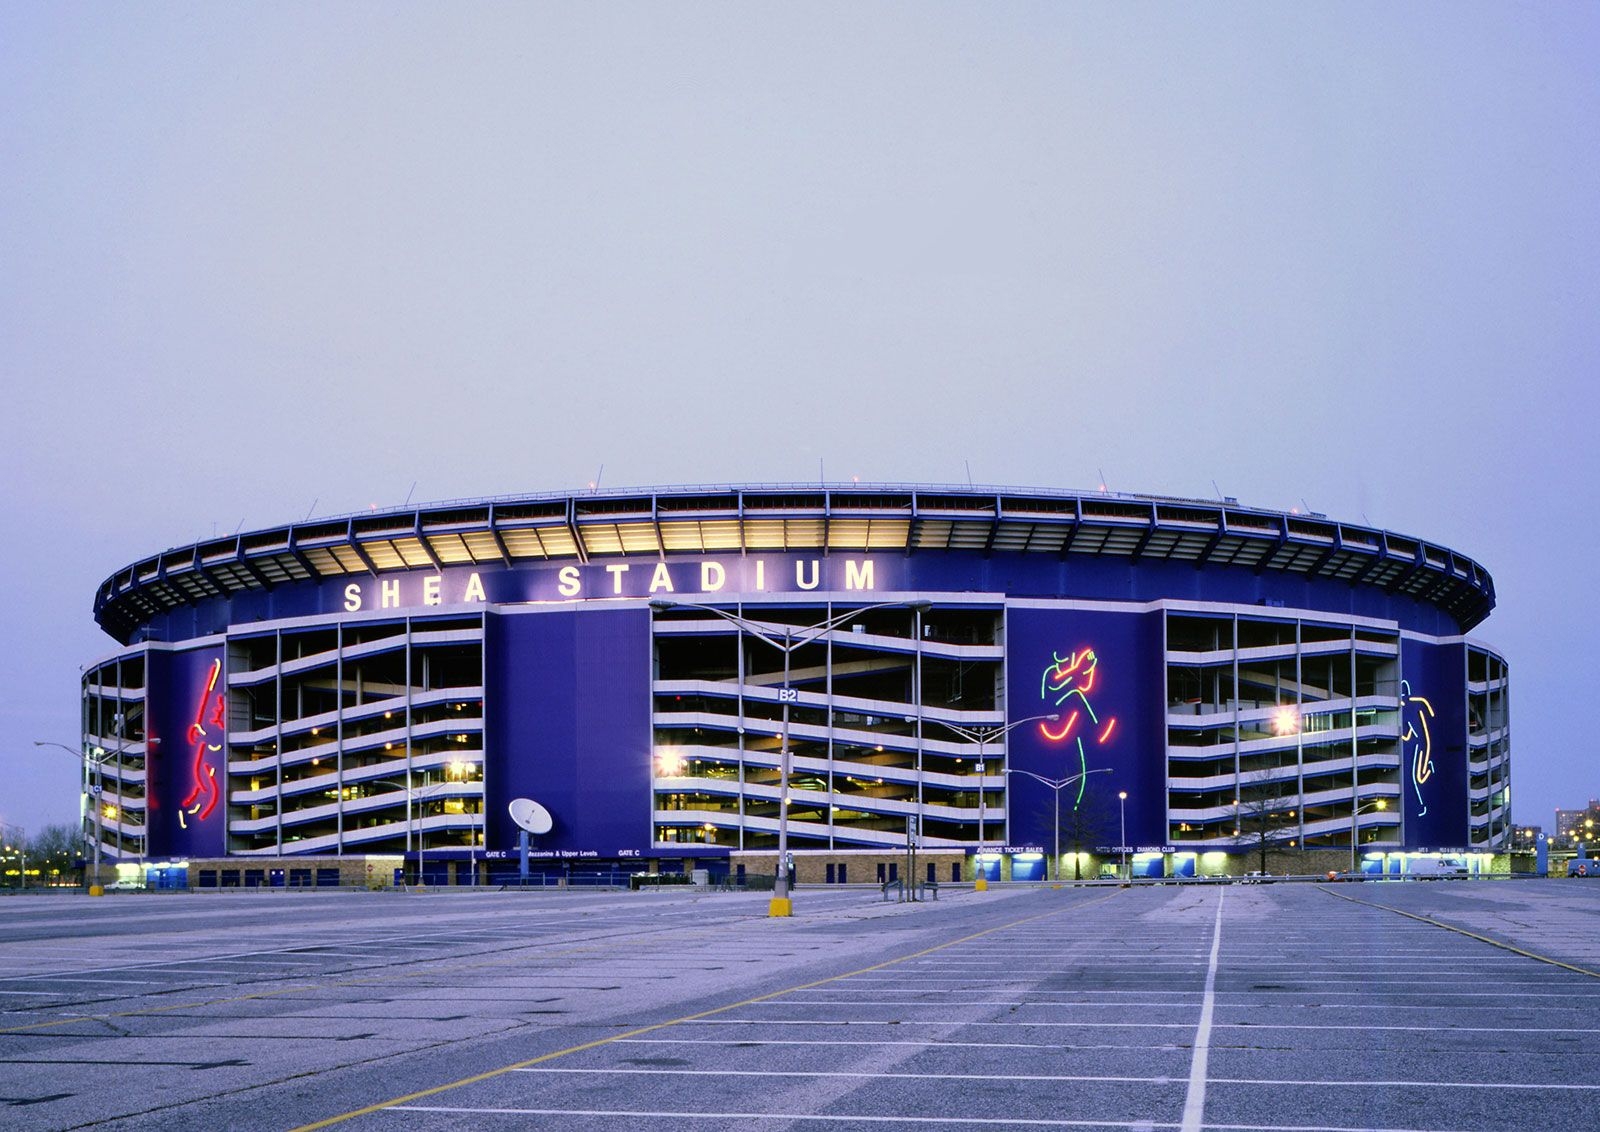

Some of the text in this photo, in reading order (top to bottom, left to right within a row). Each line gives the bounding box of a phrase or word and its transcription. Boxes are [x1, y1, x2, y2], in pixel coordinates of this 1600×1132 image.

[344, 560, 874, 612] SHEA STADIUM
[780, 689, 796, 701] B2
[976, 763, 985, 771] B1
[561, 850, 578, 858] Upper
[976, 846, 1003, 854] AVANCE
[1004, 846, 1024, 854] TICKET
